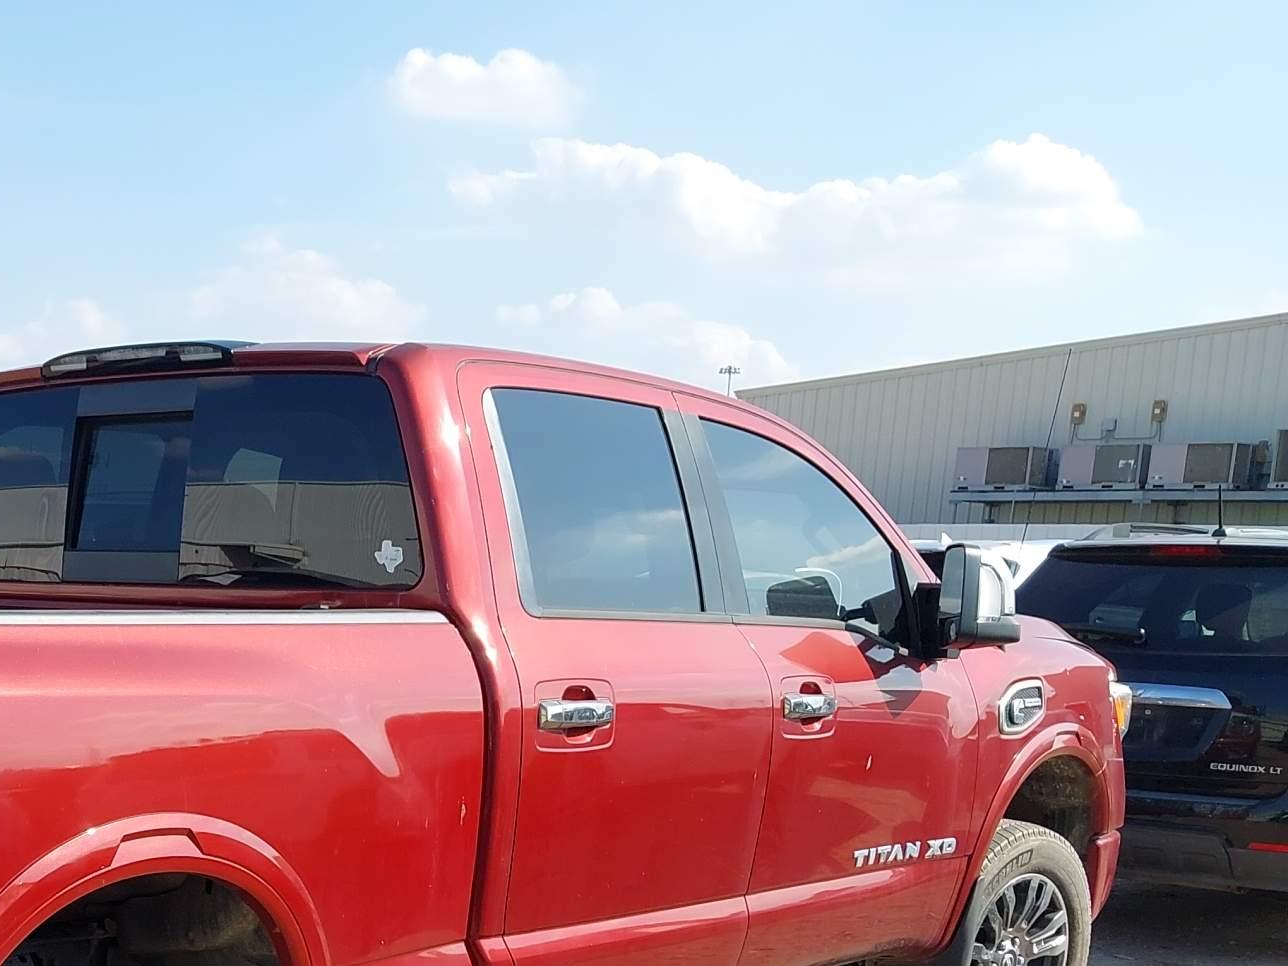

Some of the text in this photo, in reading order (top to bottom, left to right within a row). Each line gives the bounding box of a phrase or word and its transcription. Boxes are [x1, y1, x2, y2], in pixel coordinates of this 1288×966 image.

[1210, 762, 1284, 775] EQUINOX LT
[853, 837, 957, 868] TITAN XD
